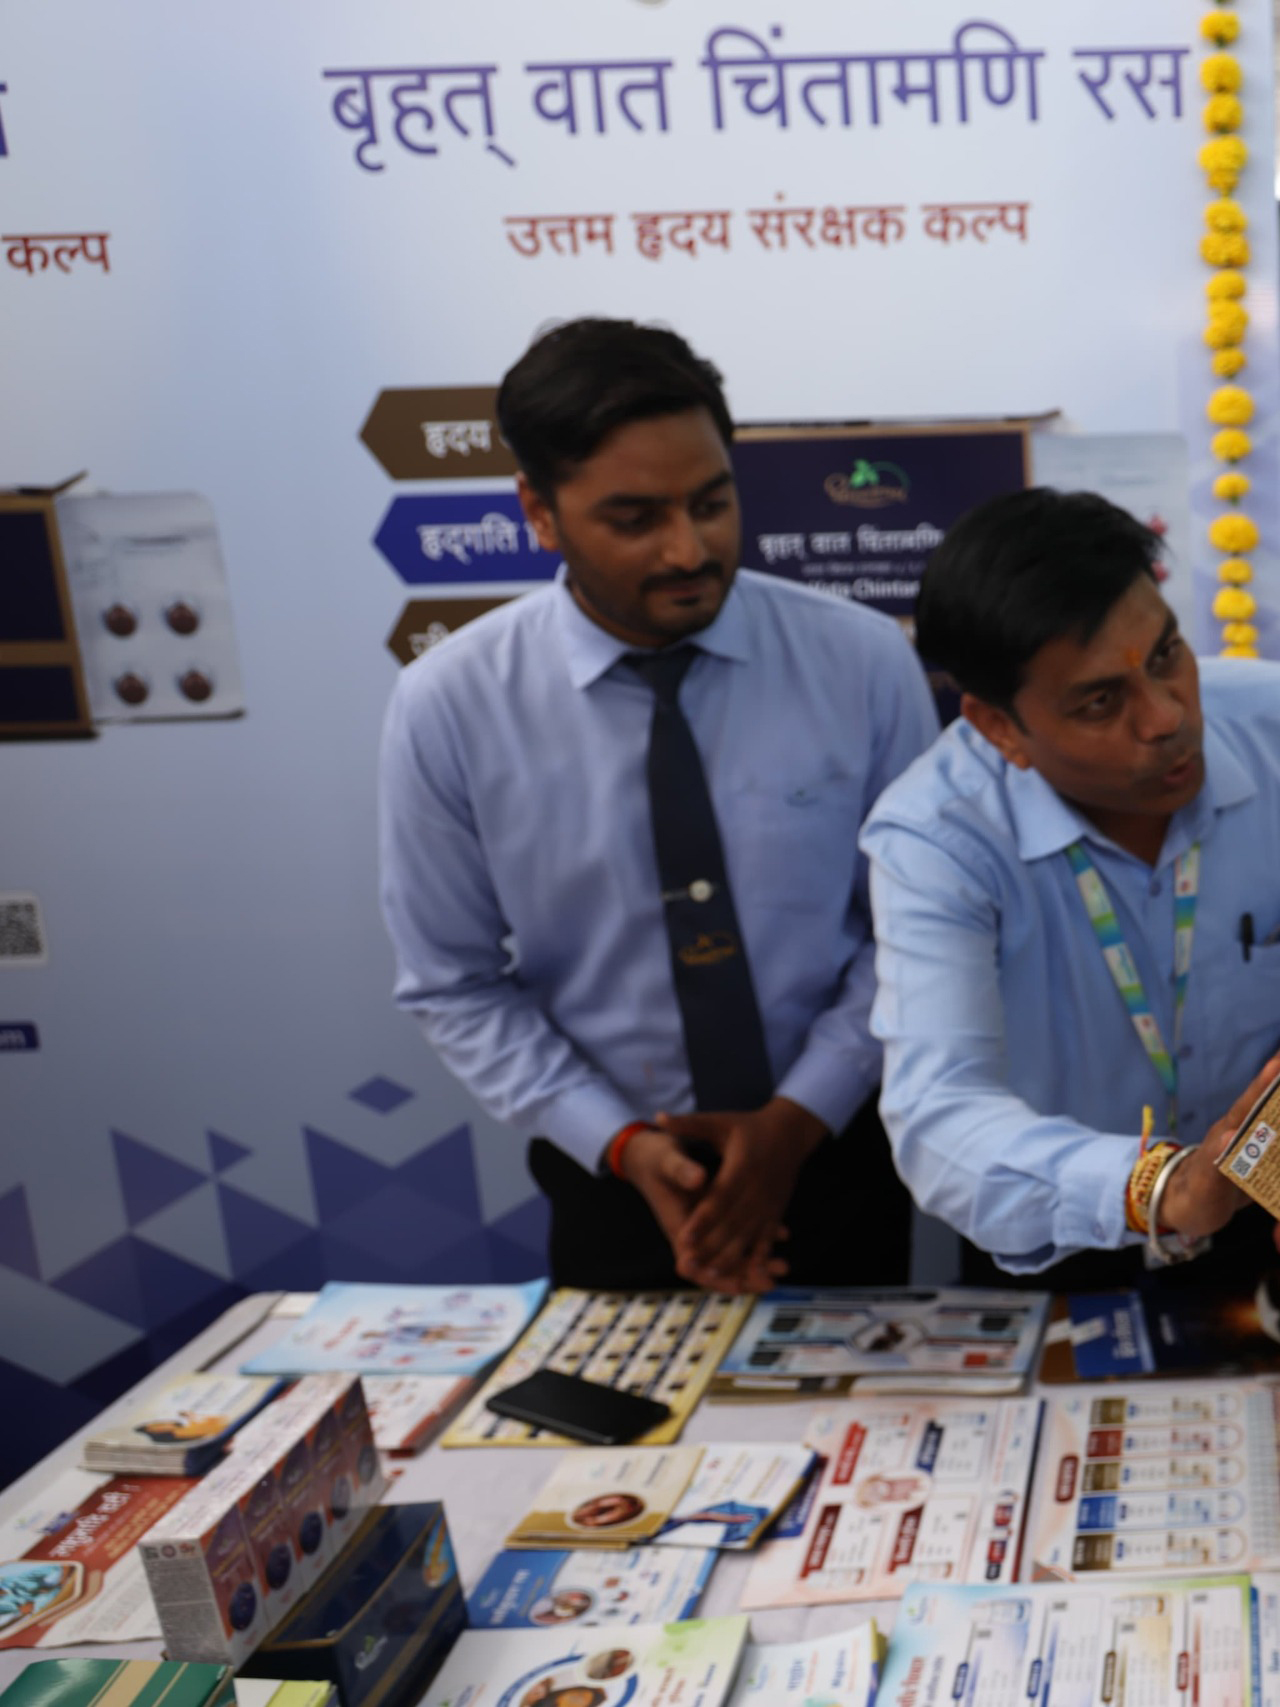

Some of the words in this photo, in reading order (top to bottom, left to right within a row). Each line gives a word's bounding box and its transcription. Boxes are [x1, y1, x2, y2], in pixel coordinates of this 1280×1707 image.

[322, 64, 516, 173] बृहत्
[524, 58, 674, 136] वात
[700, 19, 1047, 131] चिंतामणि
[1072, 46, 1191, 121] रस
[1, 232, 111, 276] कल्प
[503, 214, 617, 257] उत्तम
[631, 210, 732, 261] हृदय
[748, 192, 906, 252] संरक्षक
[922, 201, 1031, 243] कल्प
